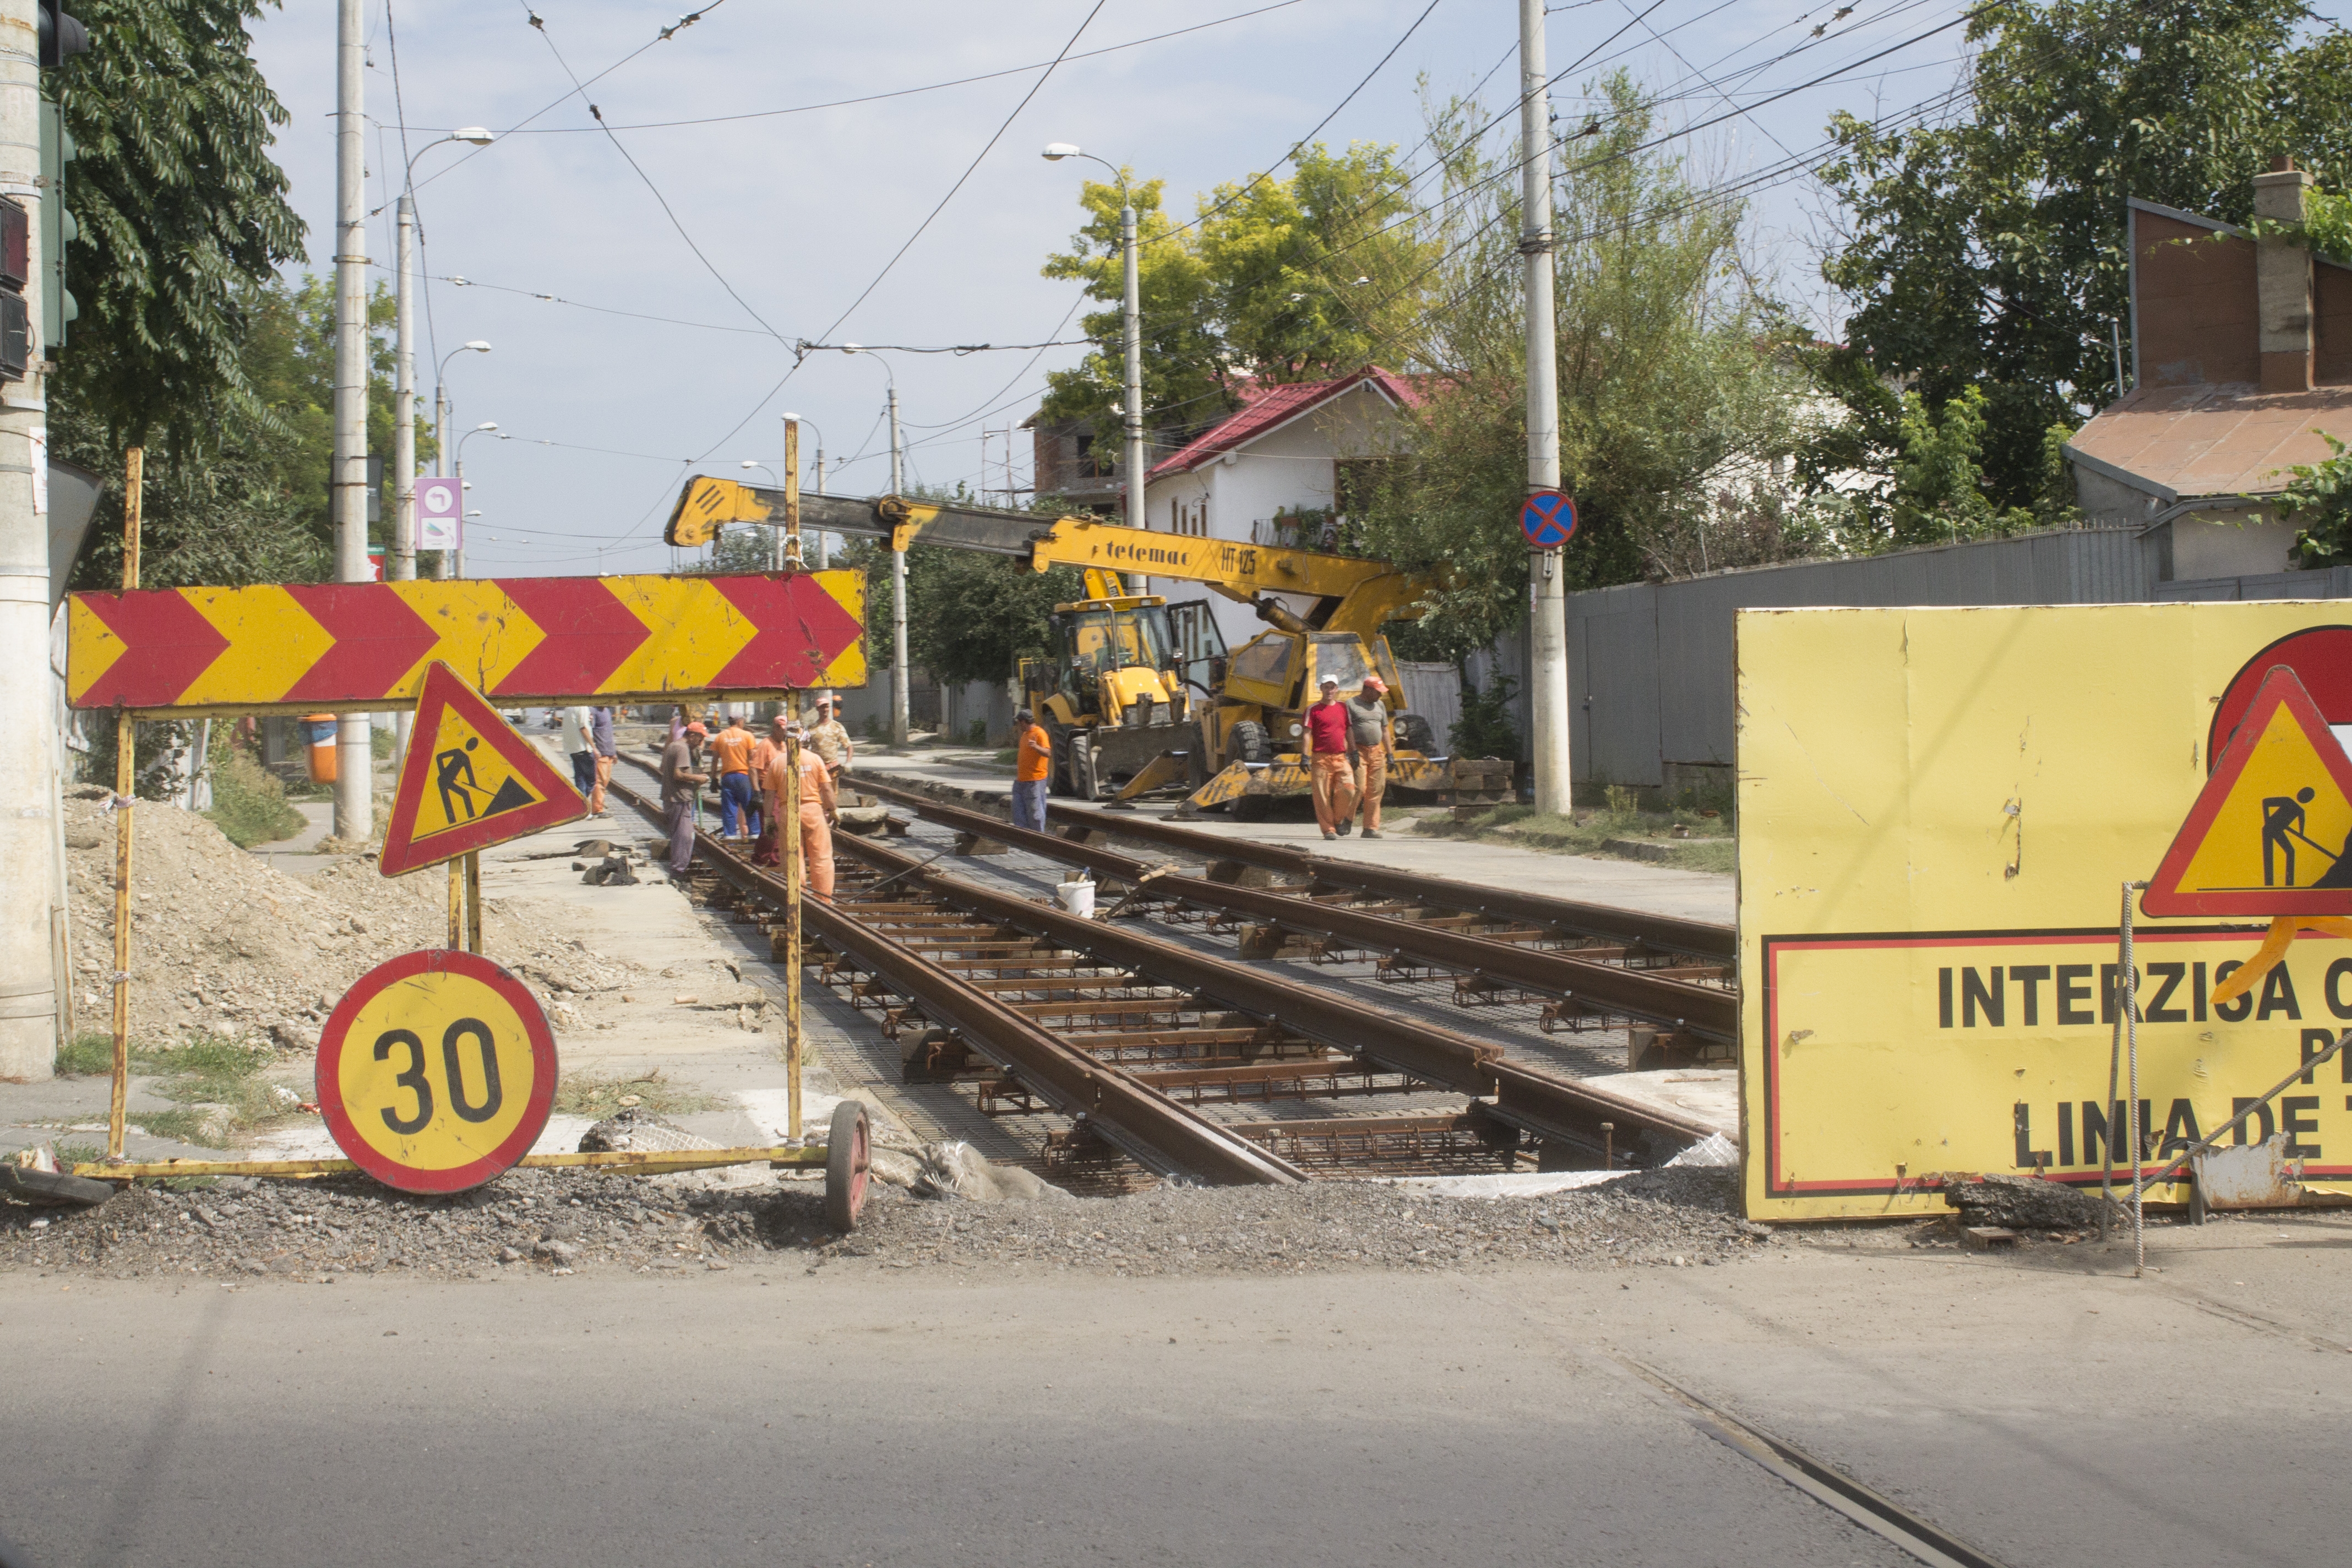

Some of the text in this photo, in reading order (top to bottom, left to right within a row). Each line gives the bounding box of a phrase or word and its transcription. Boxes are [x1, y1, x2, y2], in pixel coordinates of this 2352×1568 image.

[1221, 546, 1236, 573] HT
[1239, 549, 1256, 575] 125
[1939, 960, 2302, 1028] INTERZISA
[373, 1017, 503, 1135] 30
[2014, 1096, 2321, 1168] LINIA DE
